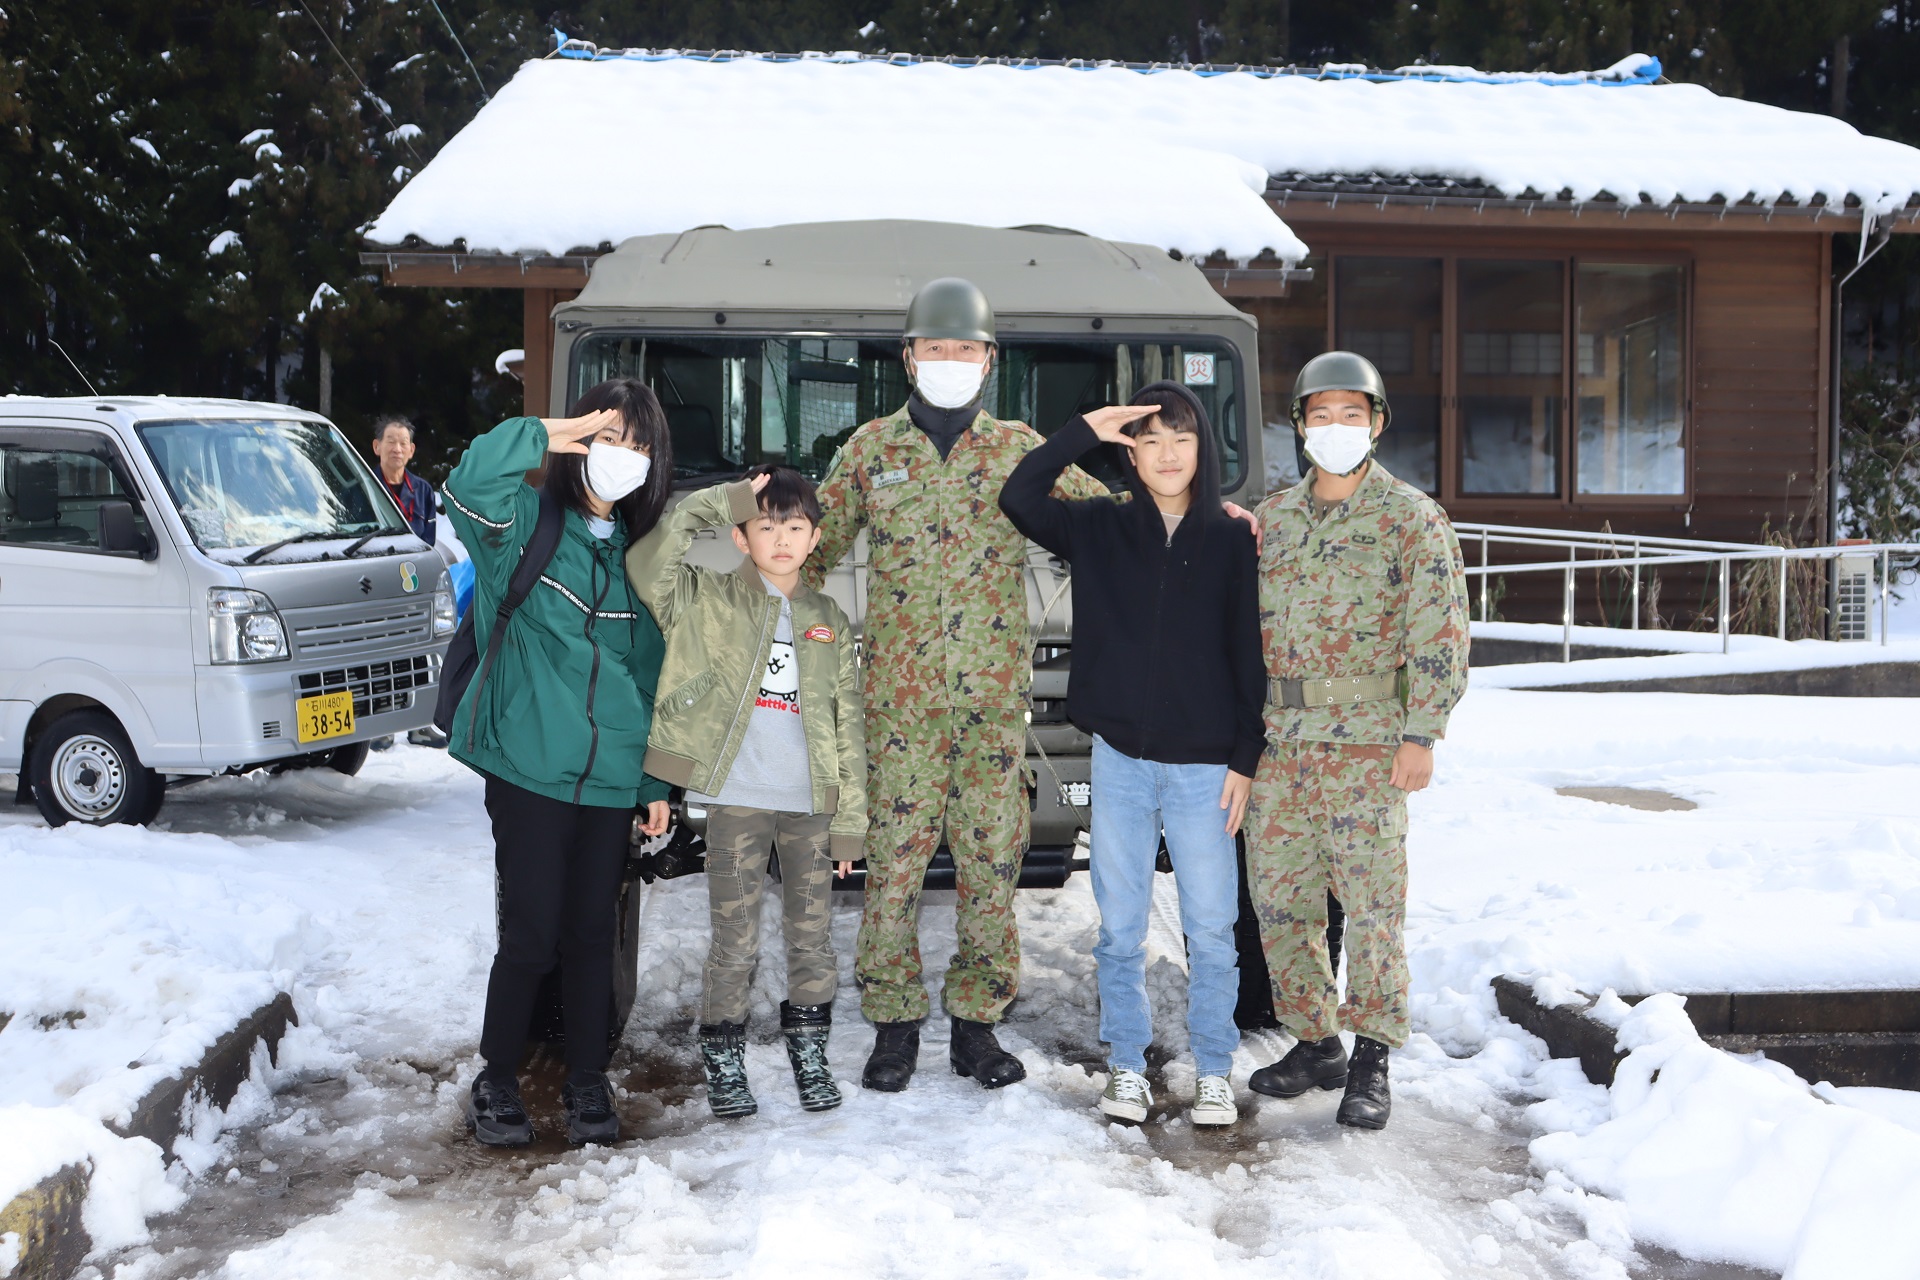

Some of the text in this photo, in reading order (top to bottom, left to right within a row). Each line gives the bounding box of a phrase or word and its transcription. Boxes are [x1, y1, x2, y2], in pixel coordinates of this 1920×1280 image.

[1190, 359, 1208, 377] 災
[756, 698, 787, 710] Battle
[311, 709, 351, 736] 38-54
